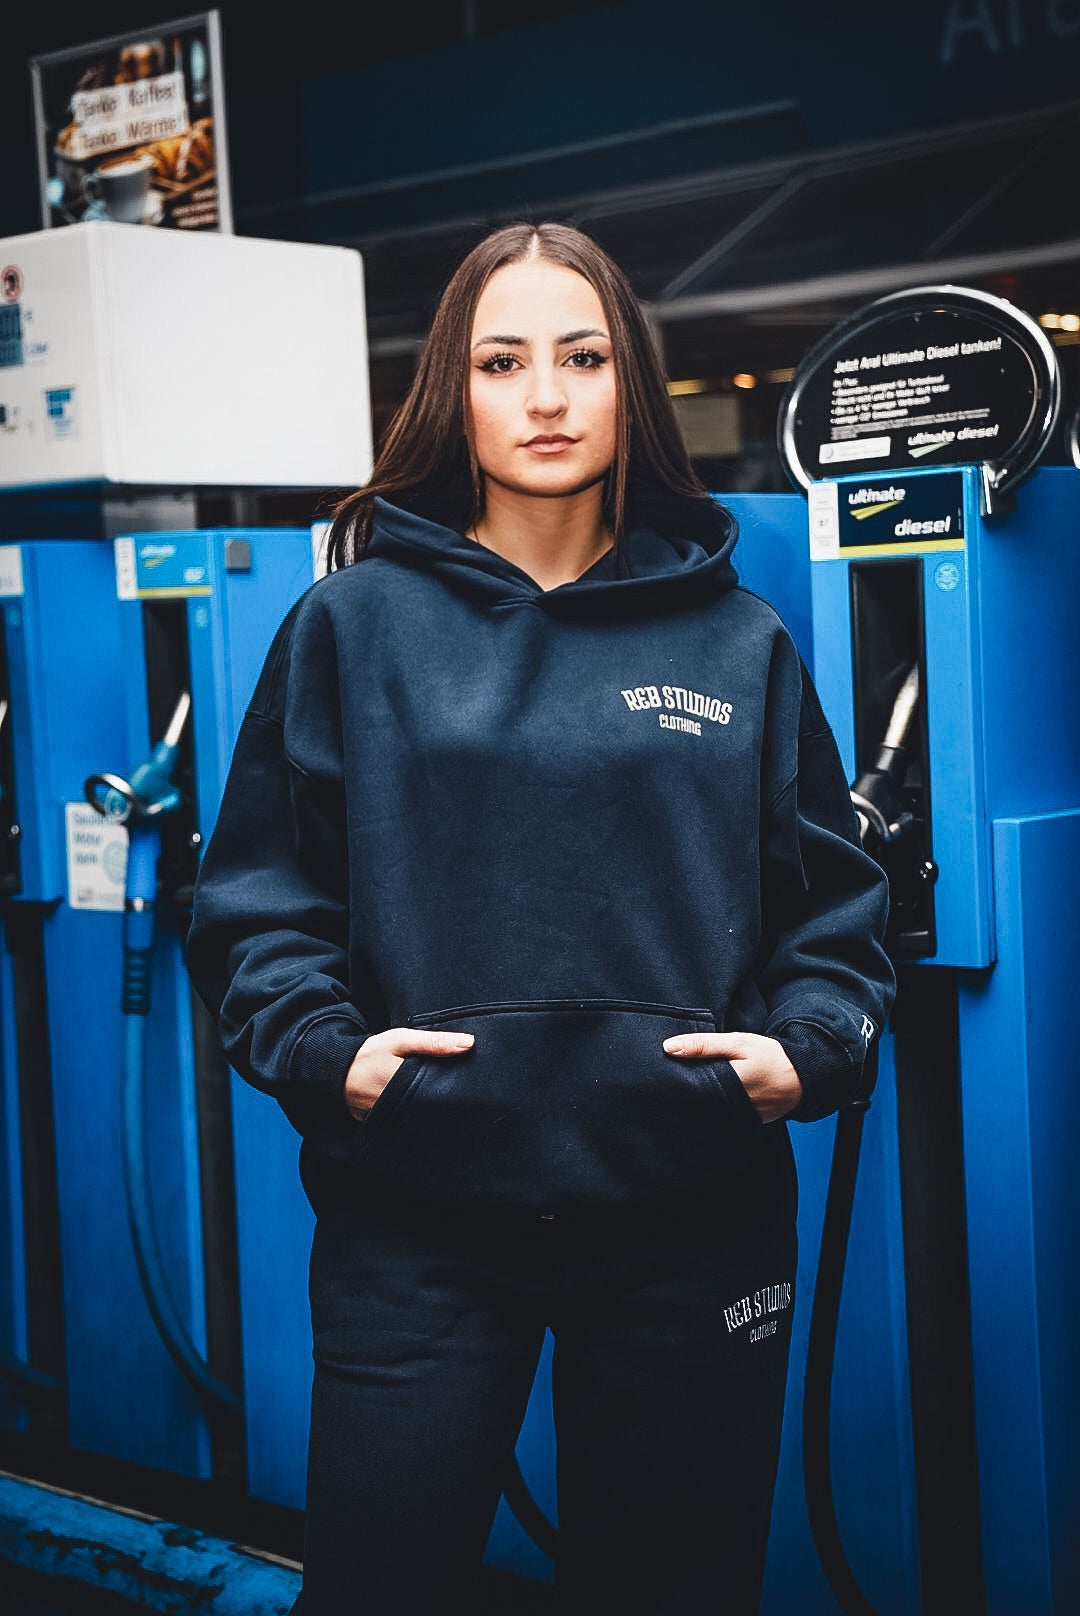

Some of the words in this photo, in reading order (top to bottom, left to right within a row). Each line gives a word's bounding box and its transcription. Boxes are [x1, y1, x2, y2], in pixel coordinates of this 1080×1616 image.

[882, 349, 926, 367] Ultimate
[926, 343, 959, 360] Diesel
[961, 336, 1002, 355] tanken!
[907, 429, 956, 446] ultimate
[956, 424, 1000, 441] diesel
[848, 486, 906, 505] ultimate
[894, 515, 952, 537] diesel
[662, 685, 733, 725] STUDIOS
[658, 713, 702, 736] CLOTHING
[753, 1282, 791, 1318] STUDIOS
